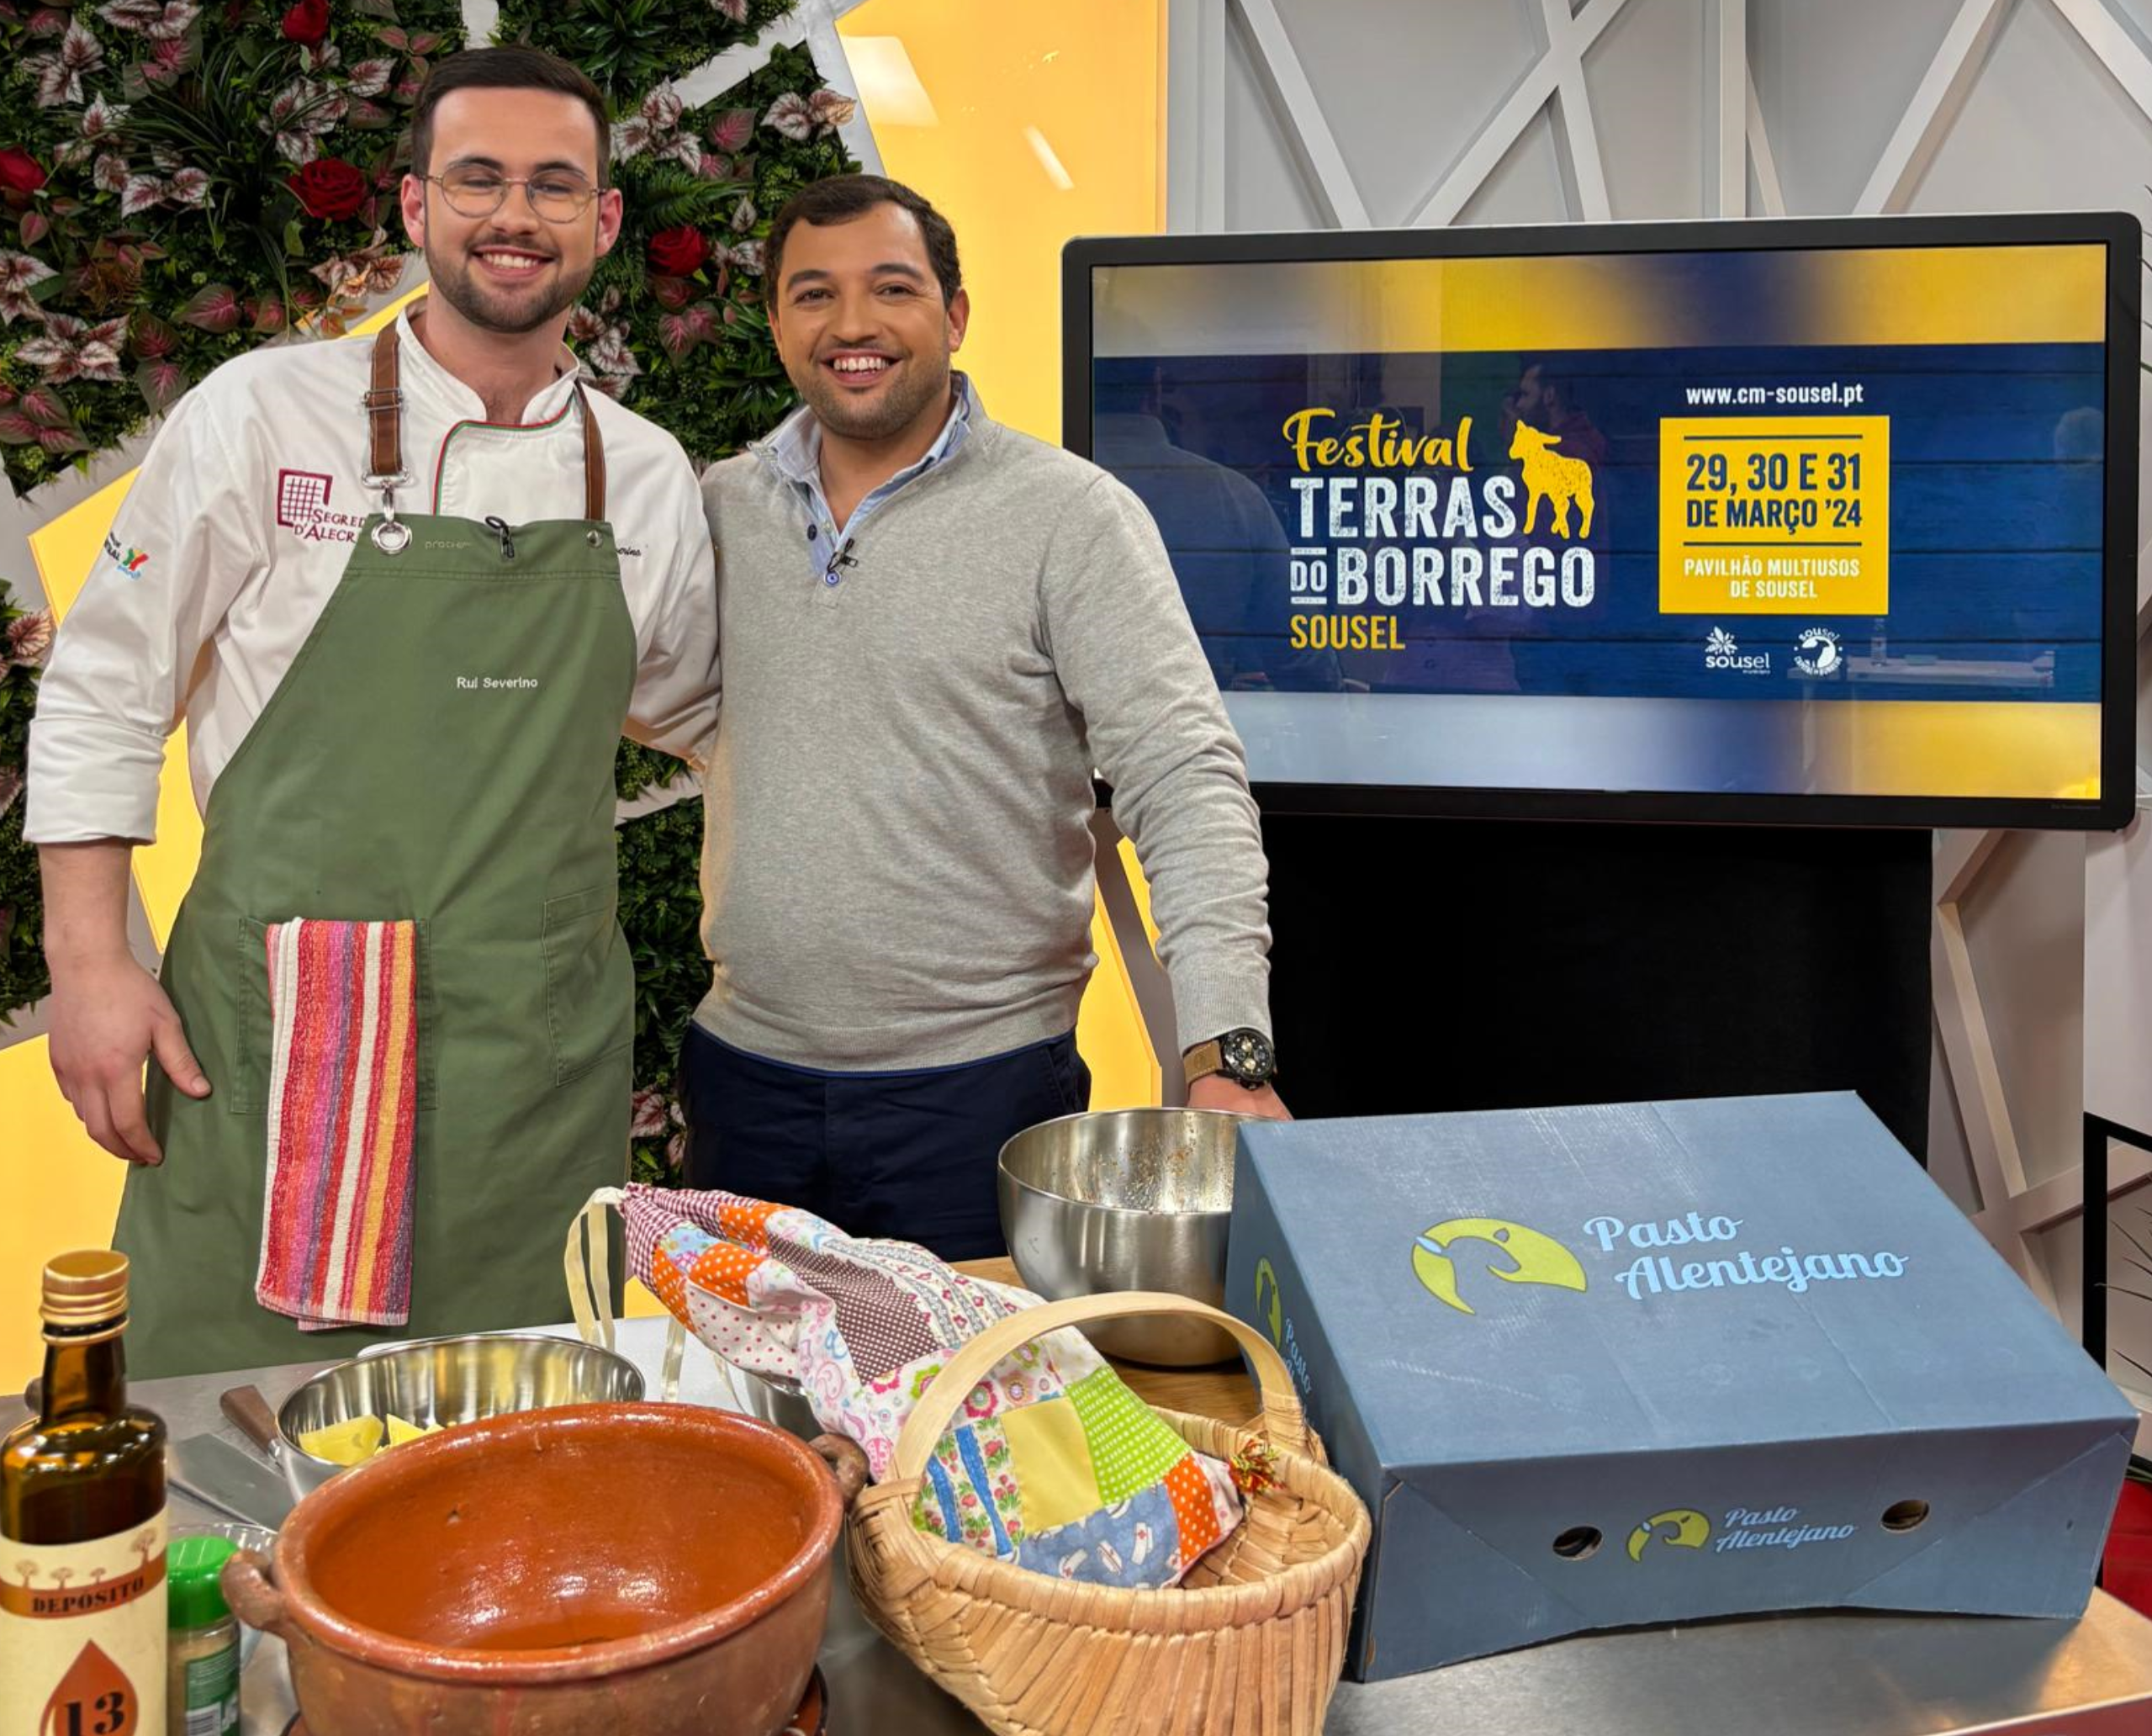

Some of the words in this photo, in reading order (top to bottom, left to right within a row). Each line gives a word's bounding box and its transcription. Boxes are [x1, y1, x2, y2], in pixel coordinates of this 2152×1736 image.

[1685, 382, 1864, 408] www.cm-sousel.pt
[1282, 407, 1474, 472] Festival
[1686, 453, 1738, 496] 29,
[1747, 453, 1789, 491] 30
[1799, 453, 1818, 491] E
[1827, 452, 1861, 490] 31
[1289, 475, 1516, 538] TERRAS
[1686, 500, 1718, 528] DE
[1726, 499, 1818, 535] MARÇO
[293, 523, 357, 543] D'ALECR
[1289, 559, 1328, 593] DO
[1336, 546, 1596, 607] BORREGO
[1684, 555, 1763, 578] PAVILHÃO
[1767, 558, 1860, 577] MULTIUSOS
[1729, 581, 1750, 599] DE
[1755, 580, 1818, 598] SOUSEL
[1289, 614, 1406, 650] SOUSEL
[1705, 651, 1770, 670] sousel
[483, 676, 538, 689] Severino
[1583, 1211, 1744, 1252] Pasto
[1615, 1246, 1910, 1300] Alentejano
[1285, 1317, 1312, 1395] Pasto
[1725, 1506, 1801, 1528] Pasto
[1716, 1524, 1859, 1553] Alentejano
[64, 1691, 124, 1736] 13
